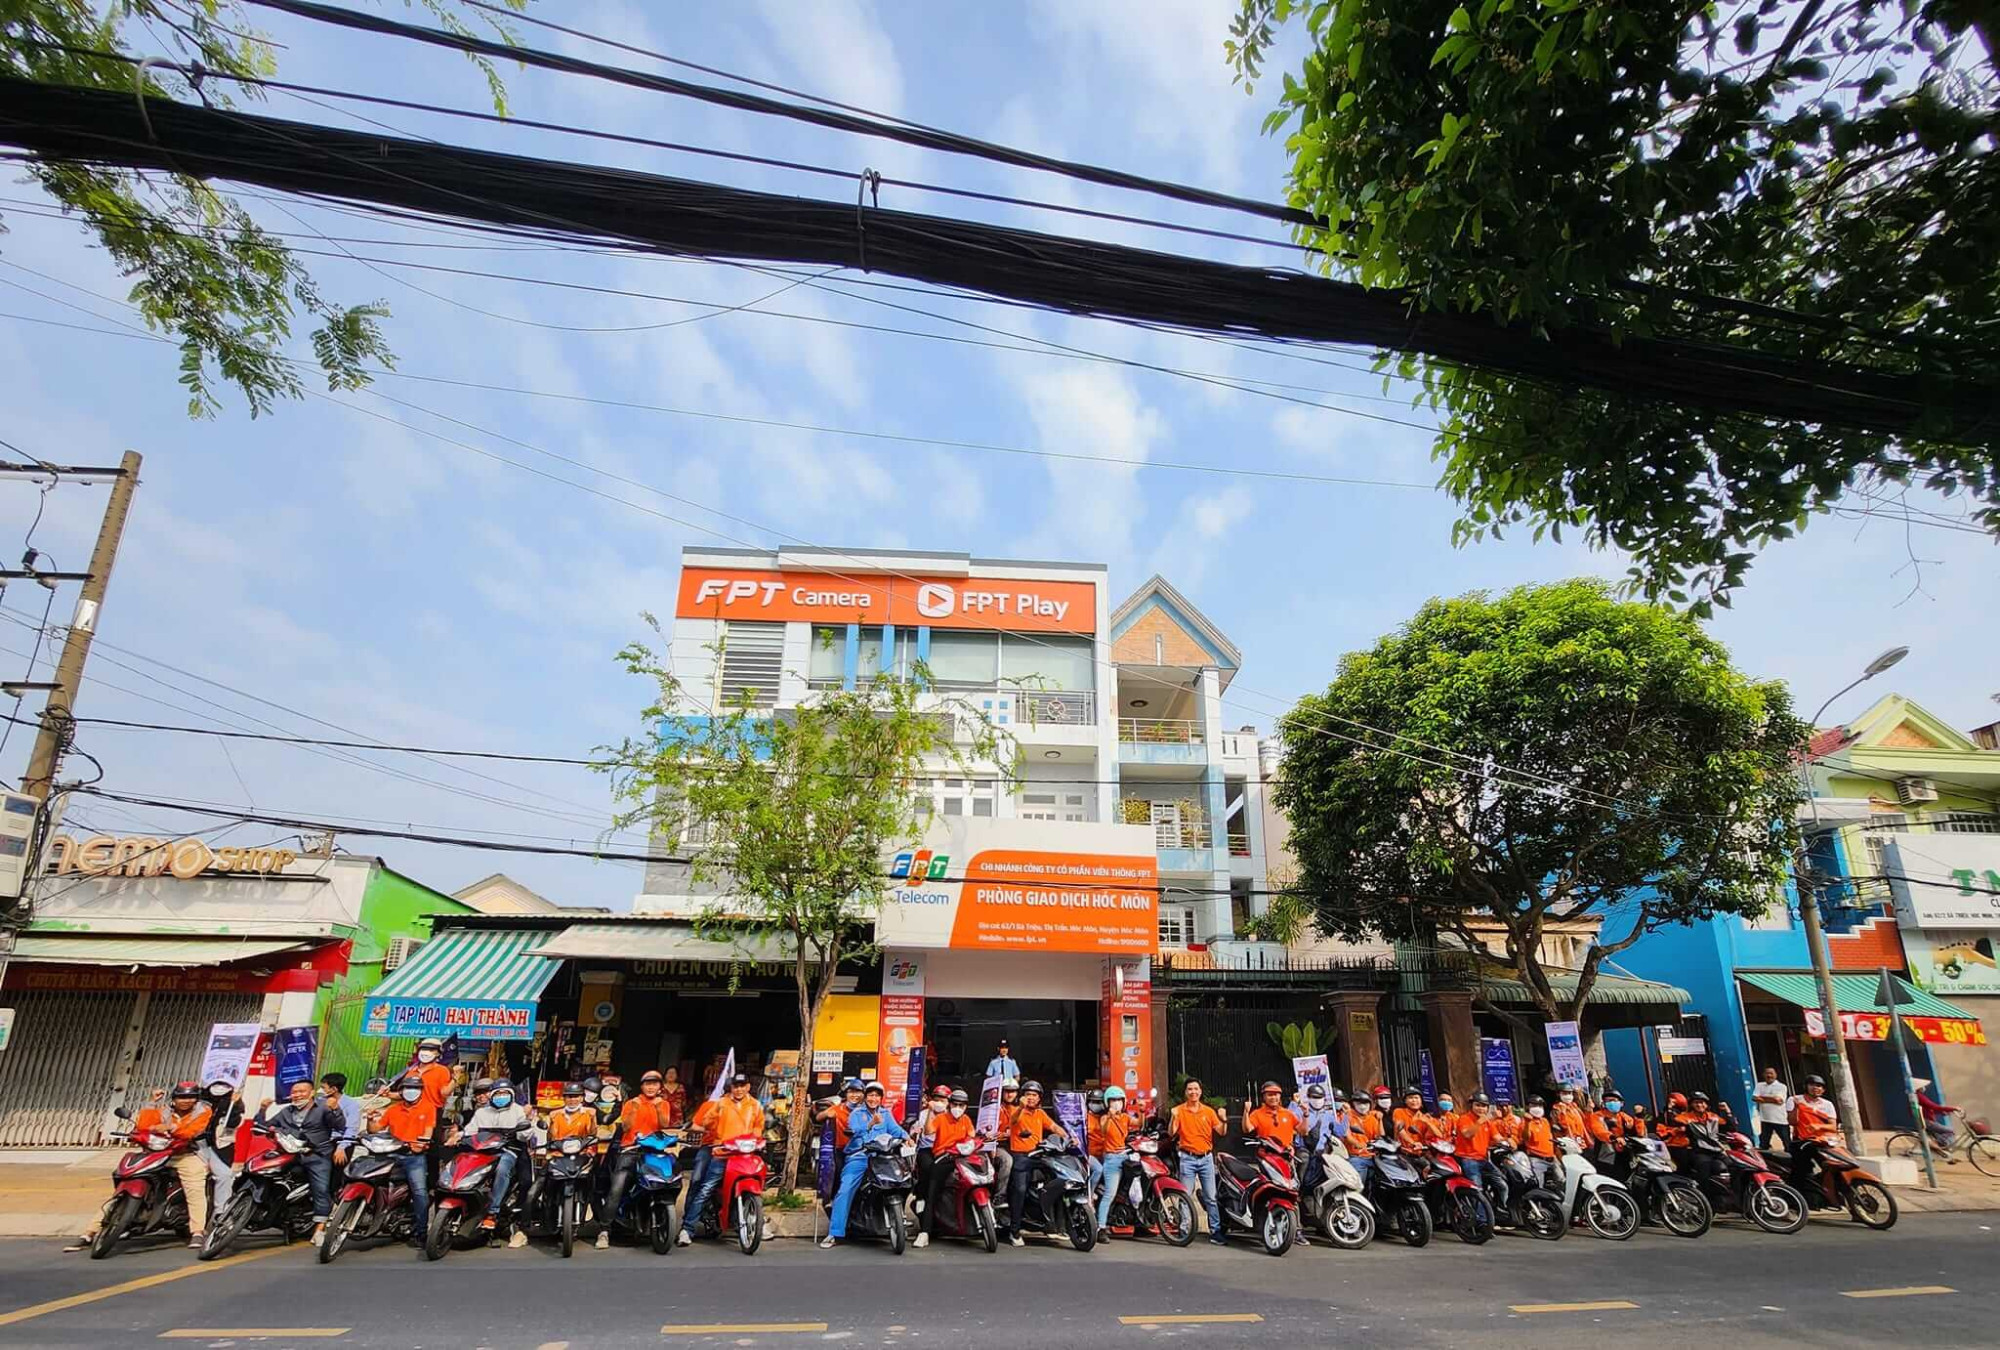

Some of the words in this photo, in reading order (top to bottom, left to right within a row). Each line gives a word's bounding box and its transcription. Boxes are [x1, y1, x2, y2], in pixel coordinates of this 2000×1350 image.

[696, 580, 785, 606] FPT
[792, 587, 872, 607] Camera
[962, 592, 1009, 613] FPT
[1017, 593, 1069, 621] Play
[218, 846, 296, 873] SHOP
[980, 863, 993, 871] CHI
[993, 862, 1022, 872] NHÁNH
[1024, 864, 1044, 873] CÔNG
[1046, 865, 1055, 874] TY
[895, 890, 949, 904] Telecom
[977, 887, 1022, 905] PHÒNG
[1026, 891, 1057, 906] GIAO
[1061, 892, 1089, 910] DỊCH
[1093, 890, 1116, 908] HÓC
[1121, 892, 1150, 910] MÔN
[890, 959, 918, 978] FPT
[1940, 1020, 1986, 1045] 50%
